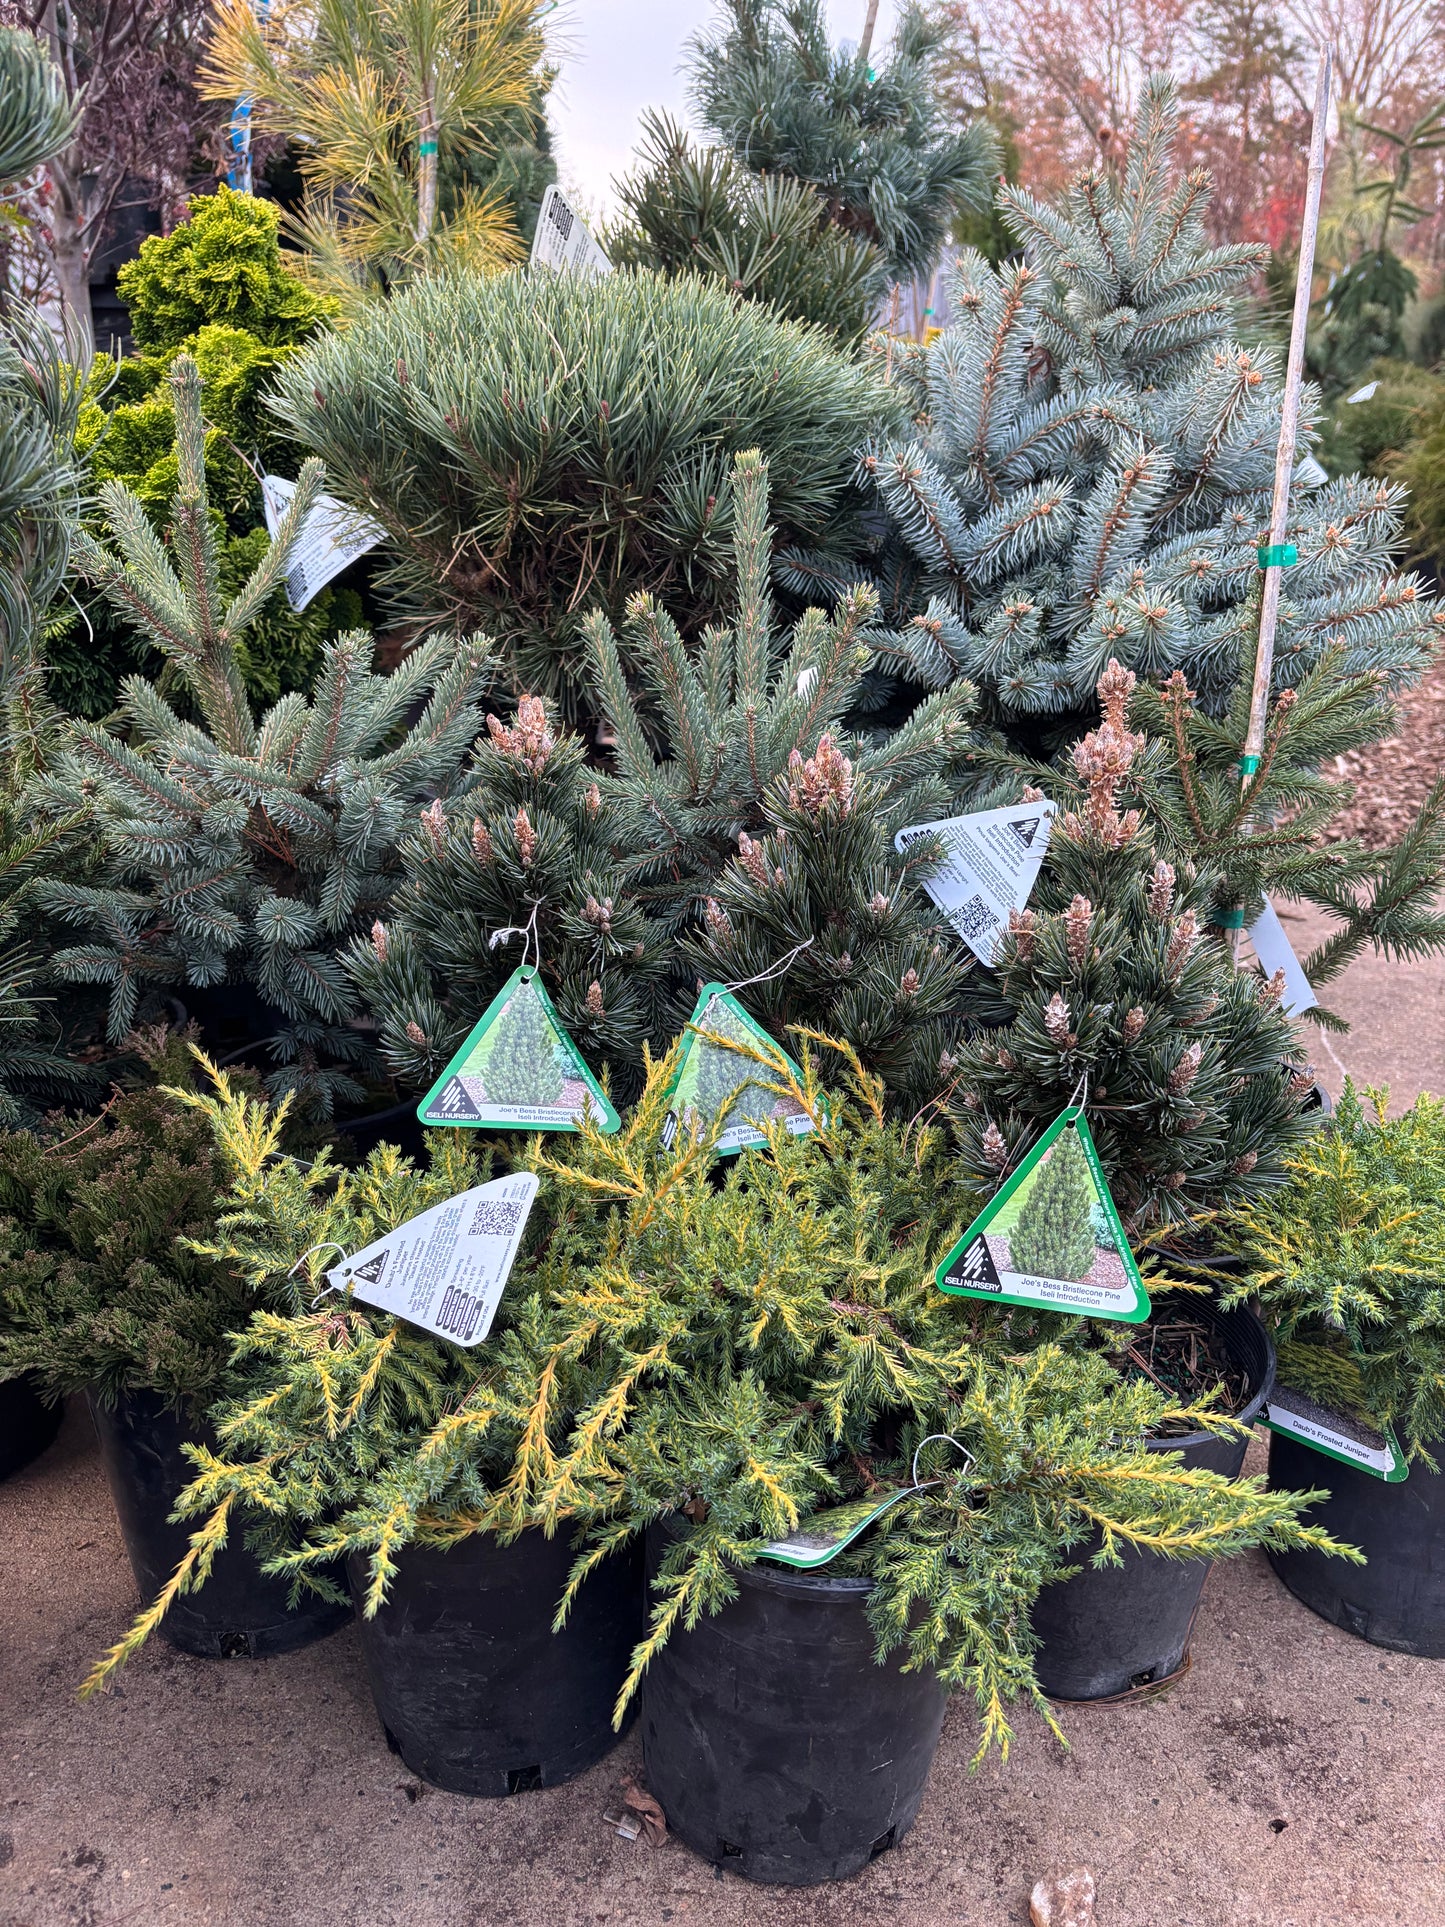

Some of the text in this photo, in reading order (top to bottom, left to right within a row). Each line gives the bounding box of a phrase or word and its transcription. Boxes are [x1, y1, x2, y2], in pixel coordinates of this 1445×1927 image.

[991, 823, 1025, 863] Bristlecone Pine
[994, 837, 1020, 868] Introduction
[538, 1108, 576, 1116] Bristlecone
[795, 1116, 810, 1124] Pine
[722, 1130, 736, 1138] oe's
[1080, 1136, 1093, 1156] Where
[1089, 1165, 1104, 1188] Beauty
[1099, 1194, 1113, 1215] Nature
[1107, 1214, 1120, 1234] Meets
[1114, 1233, 1124, 1245] The
[1118, 1245, 1133, 1269] Artistry
[945, 1276, 1000, 1292] ISELI NURSERY
[1021, 1278, 1120, 1301] Joe's Bess Bristlecone Pine
[1040, 1289, 1100, 1305] Iseli Introduction
[1293, 1420, 1370, 1459] Daub's Frosted Juniper
